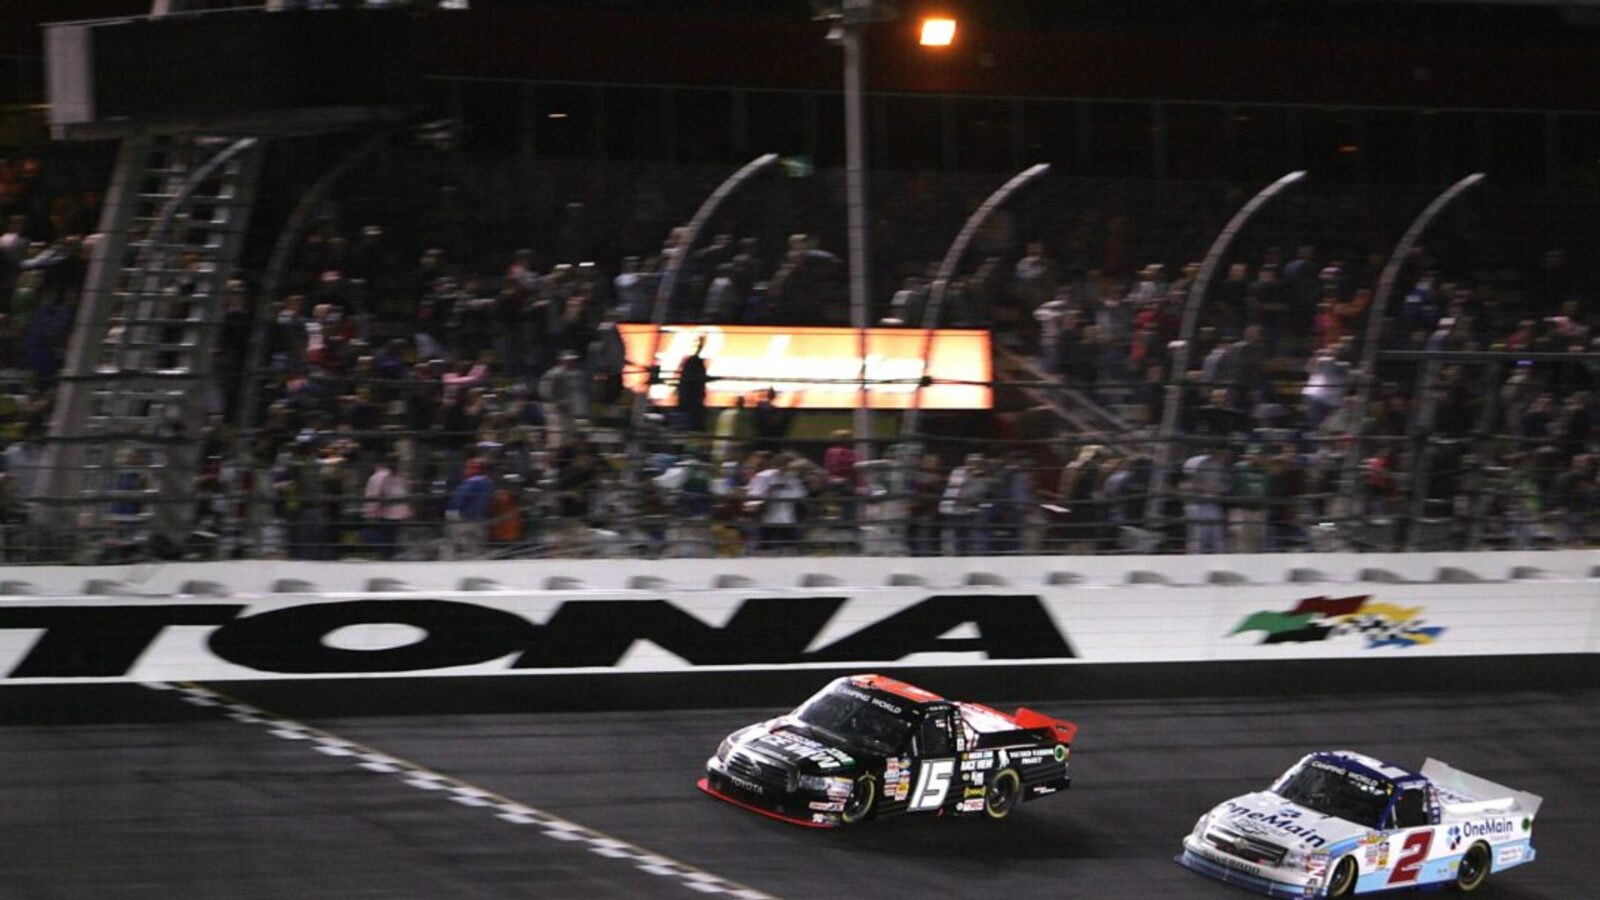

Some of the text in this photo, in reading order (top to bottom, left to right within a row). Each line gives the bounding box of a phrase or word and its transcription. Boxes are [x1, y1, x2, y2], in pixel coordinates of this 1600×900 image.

[0, 594, 1077, 678] TONA
[872, 698, 901, 714] WORLD
[731, 776, 764, 795] TOYOTA
[906, 758, 955, 812] 15
[1463, 817, 1514, 838] OneMain
[1387, 828, 1435, 886] 2
